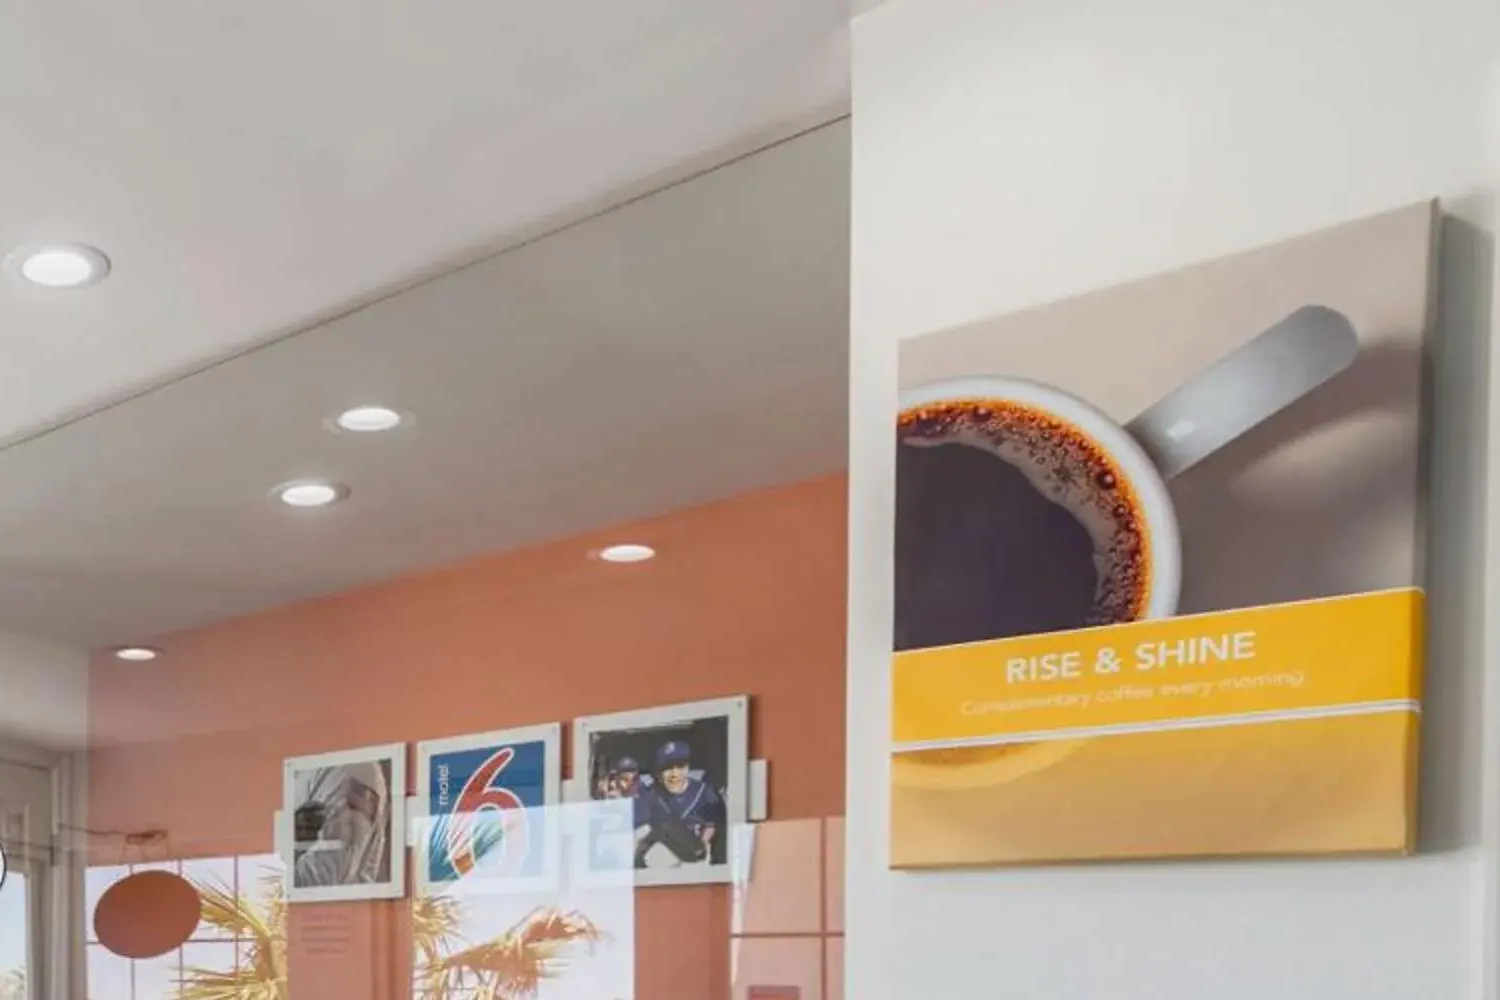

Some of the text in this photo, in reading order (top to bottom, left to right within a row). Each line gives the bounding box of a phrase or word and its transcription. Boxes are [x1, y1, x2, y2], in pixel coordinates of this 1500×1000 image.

[1006, 630, 1257, 685] RISE & SHINE
[1095, 683, 1154, 703] coffee
[1159, 681, 1215, 699] every
[438, 747, 530, 880] motel 6
